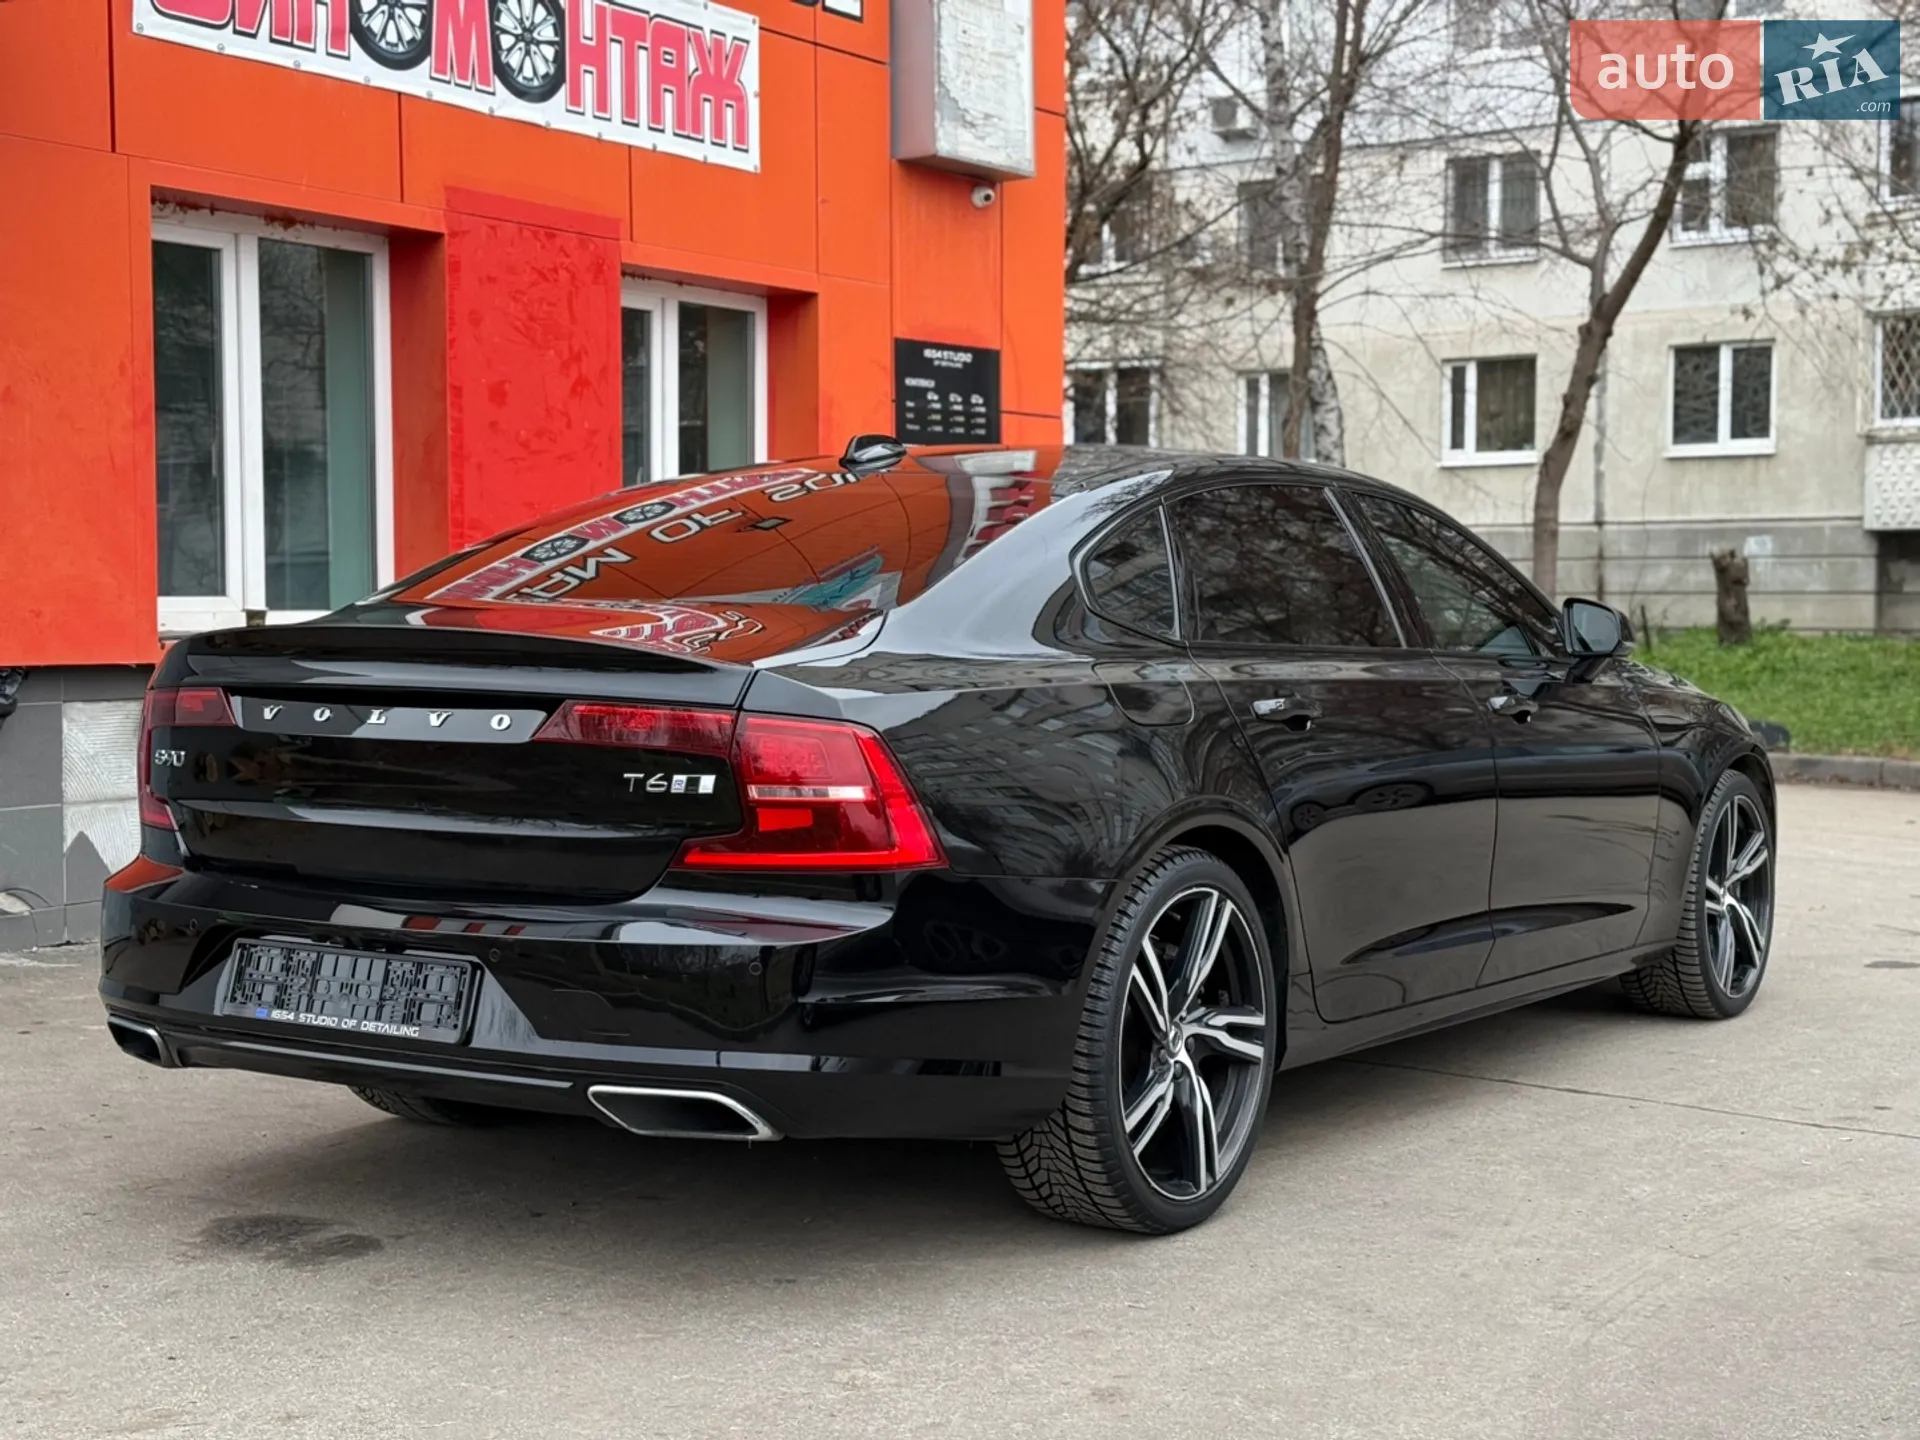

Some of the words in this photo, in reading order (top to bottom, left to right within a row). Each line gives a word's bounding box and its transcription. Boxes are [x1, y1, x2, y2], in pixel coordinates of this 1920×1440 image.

[261, 704, 511, 731] VOLVO
[623, 773, 668, 793] T6
[299, 1013, 338, 1027] STUDIO
[341, 1018, 357, 1029] OF
[361, 1021, 420, 1037] DETAILING
